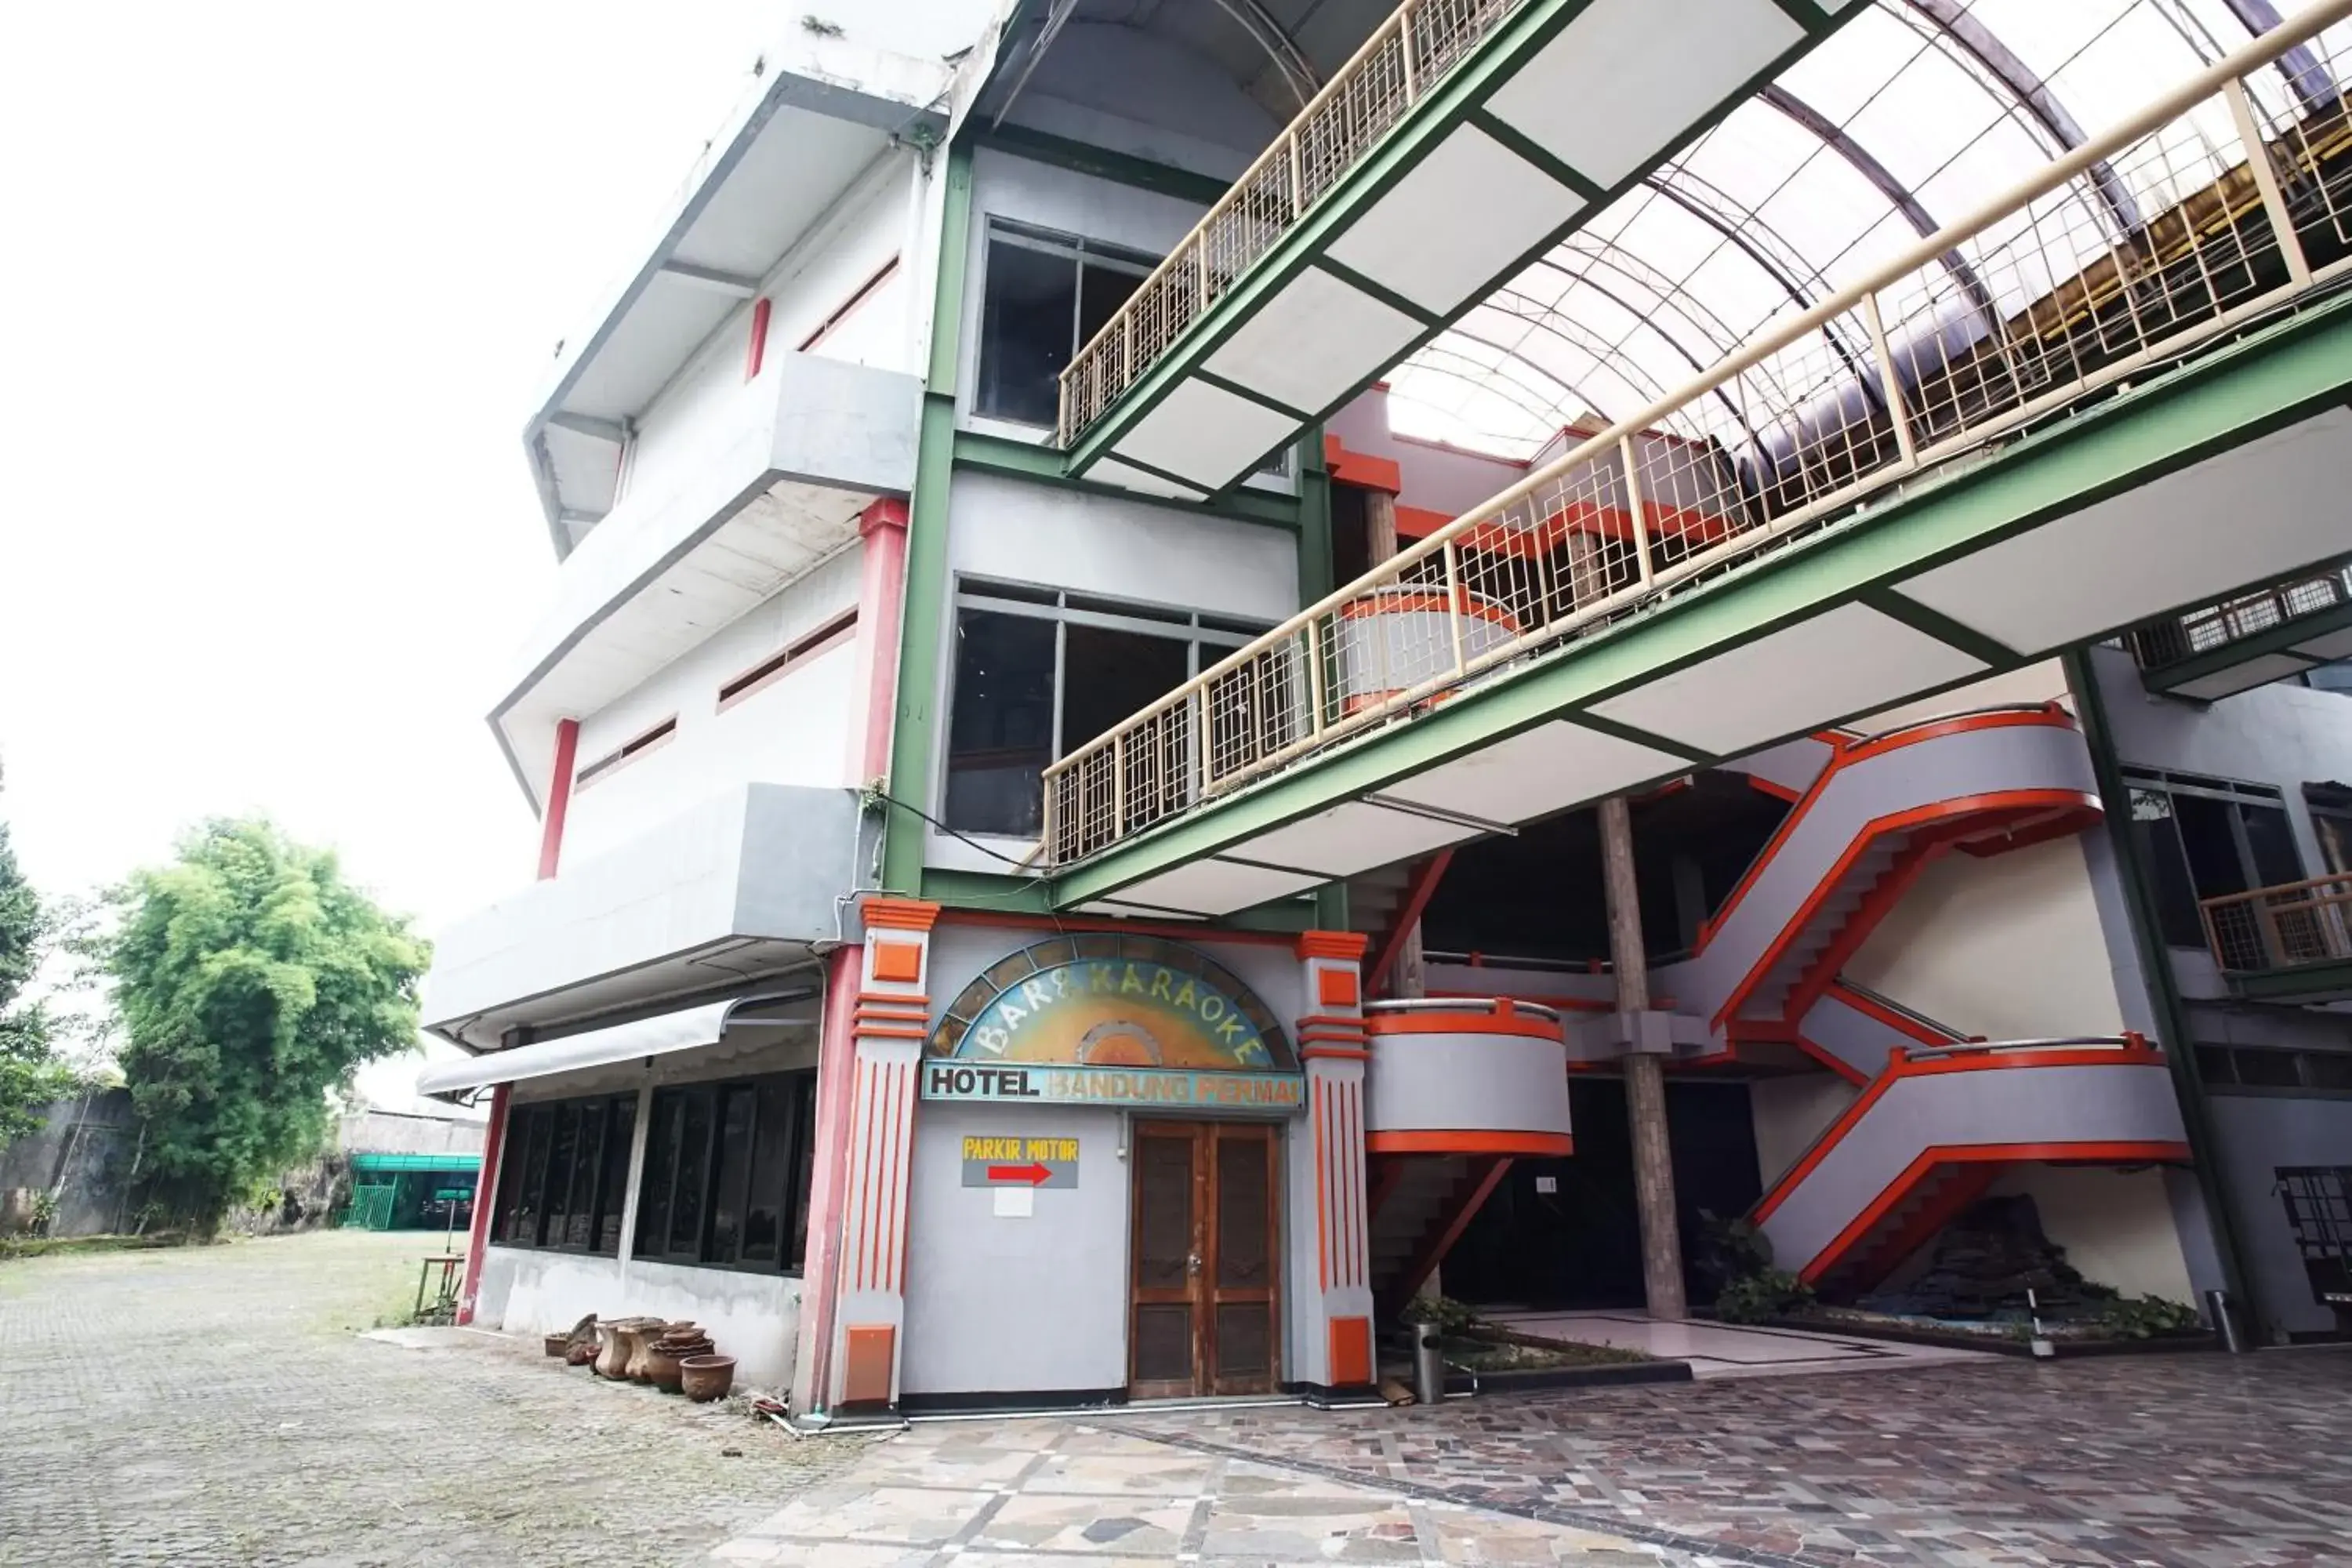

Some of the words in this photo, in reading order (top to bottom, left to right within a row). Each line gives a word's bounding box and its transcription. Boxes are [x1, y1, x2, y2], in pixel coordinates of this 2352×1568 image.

[975, 980, 1053, 1054] BAR
[1088, 962, 1262, 1065] KARAOKE
[931, 1068, 1040, 1096] HOTEL
[1051, 1071, 1189, 1102] BANDUNG
[1197, 1076, 1298, 1103] PERMAI
[964, 1138, 1022, 1160] PARKIR
[1026, 1139, 1078, 1161] MOTOR
